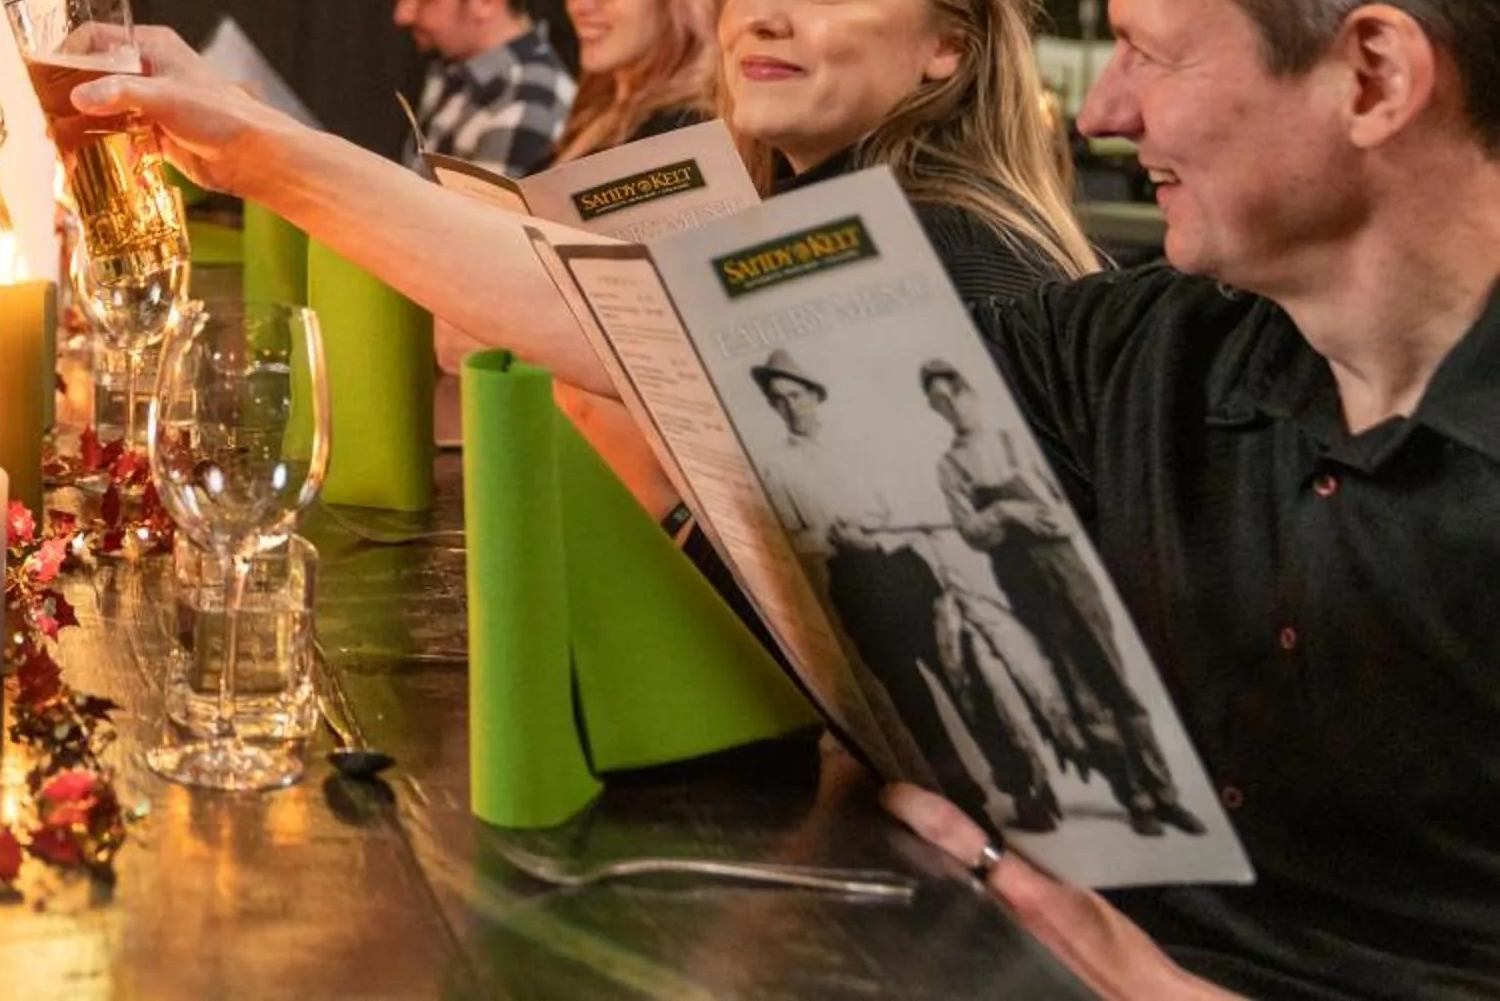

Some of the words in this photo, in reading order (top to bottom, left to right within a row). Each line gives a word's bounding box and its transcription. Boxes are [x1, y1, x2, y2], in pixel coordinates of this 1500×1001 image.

[581, 181, 637, 210] SANDY
[651, 166, 692, 189] KELT
[807, 224, 863, 261] KELT
